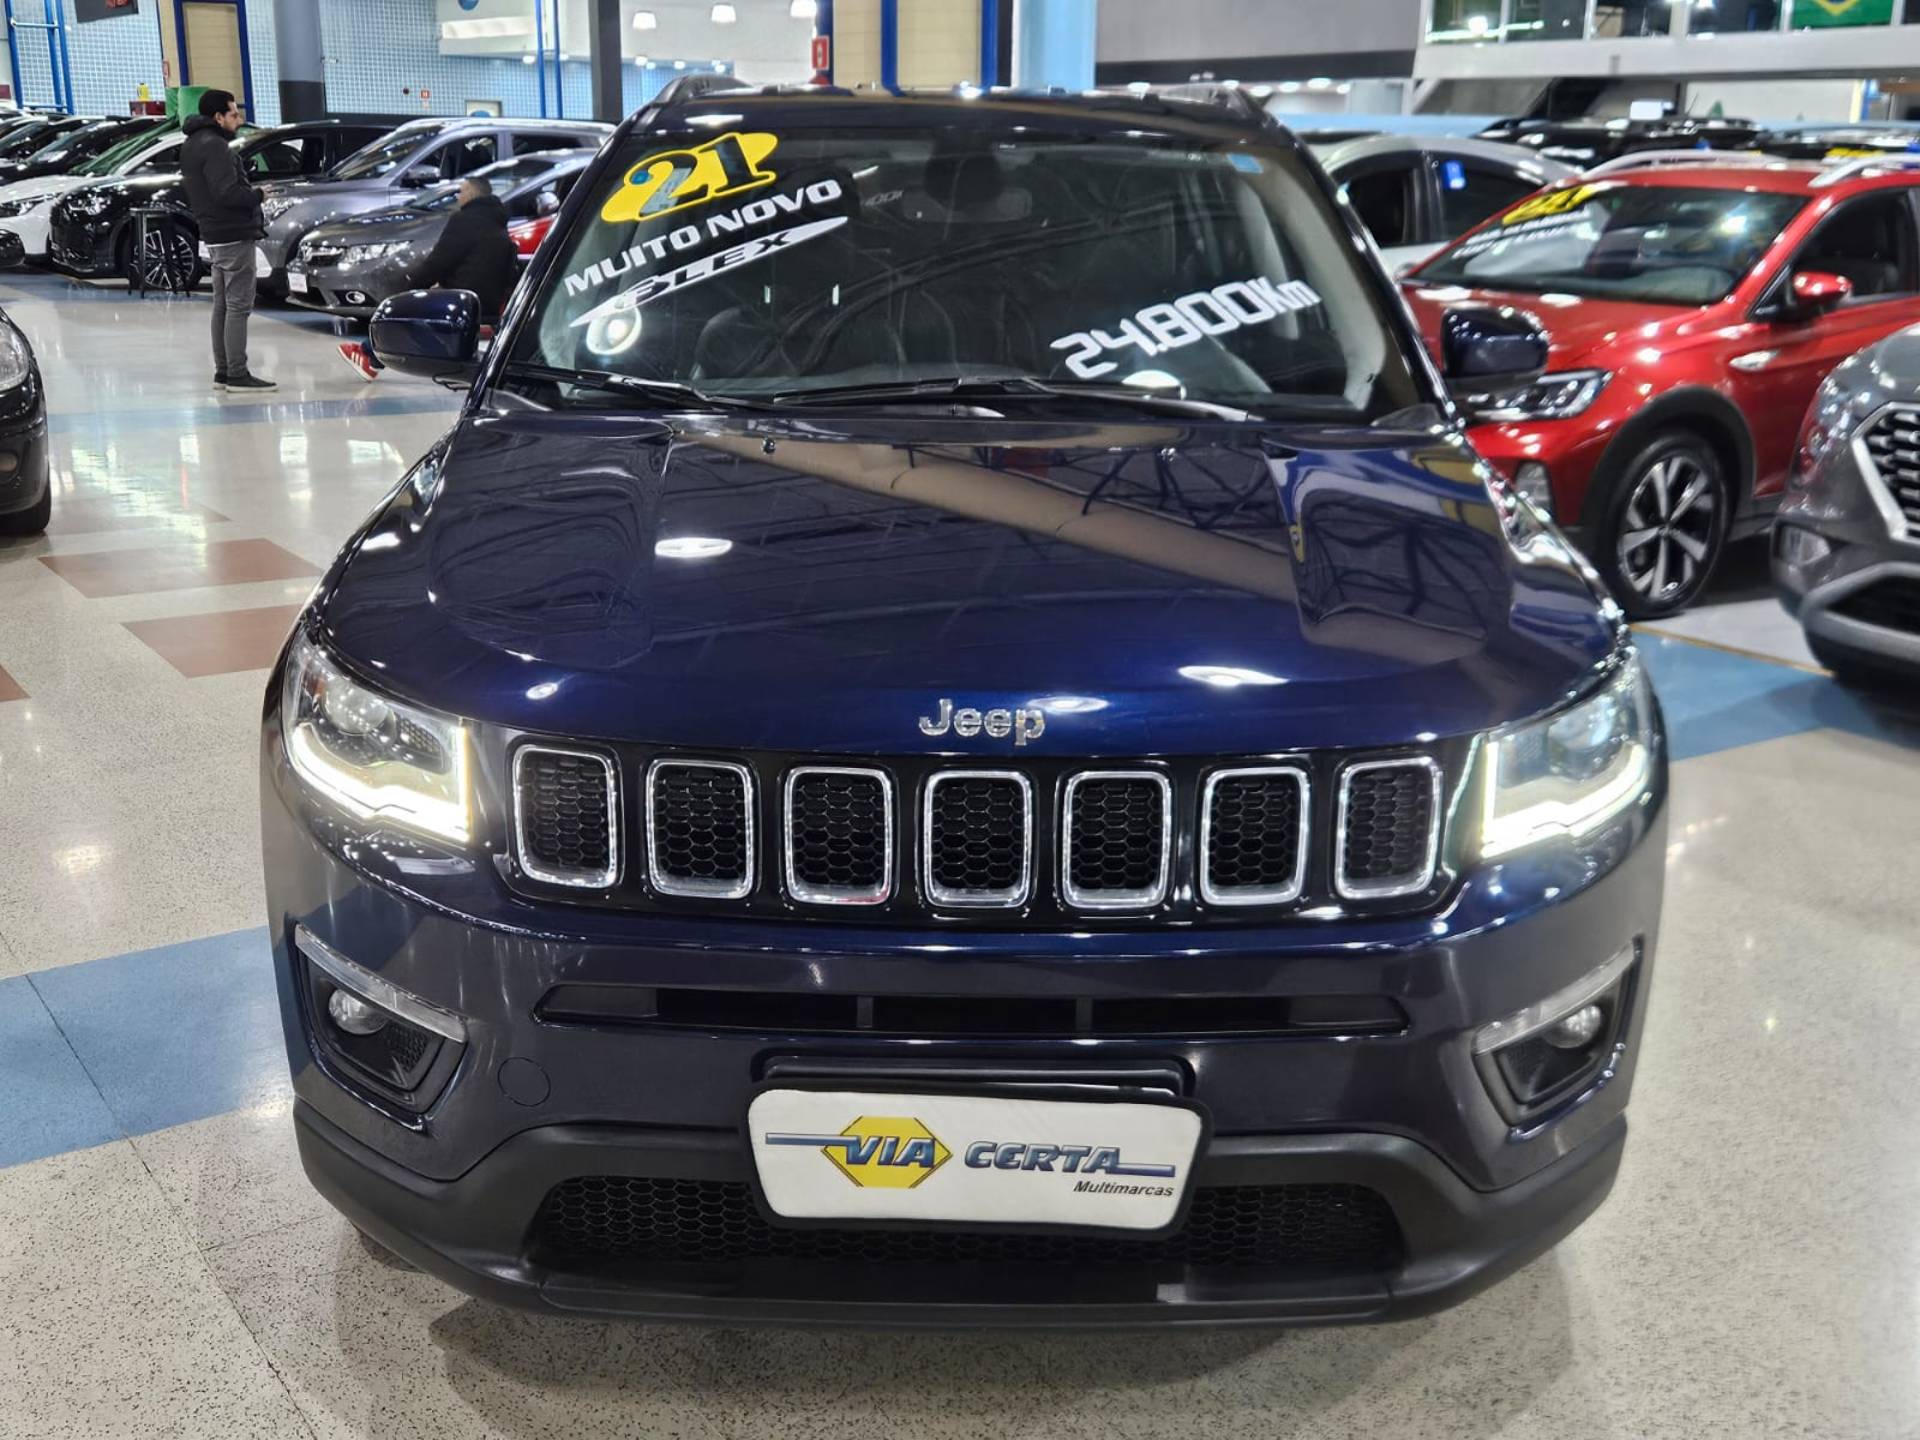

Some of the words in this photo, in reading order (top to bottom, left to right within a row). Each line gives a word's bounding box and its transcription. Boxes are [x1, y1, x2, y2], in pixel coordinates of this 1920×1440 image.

[606, 132, 778, 222] 21
[563, 225, 701, 297] MUITO
[706, 179, 843, 238] NOVO
[918, 698, 1046, 746] Jeep
[843, 1135, 937, 1169] VIA
[963, 1140, 1121, 1174] CERTA
[1072, 1179, 1176, 1198] Multimarcas
